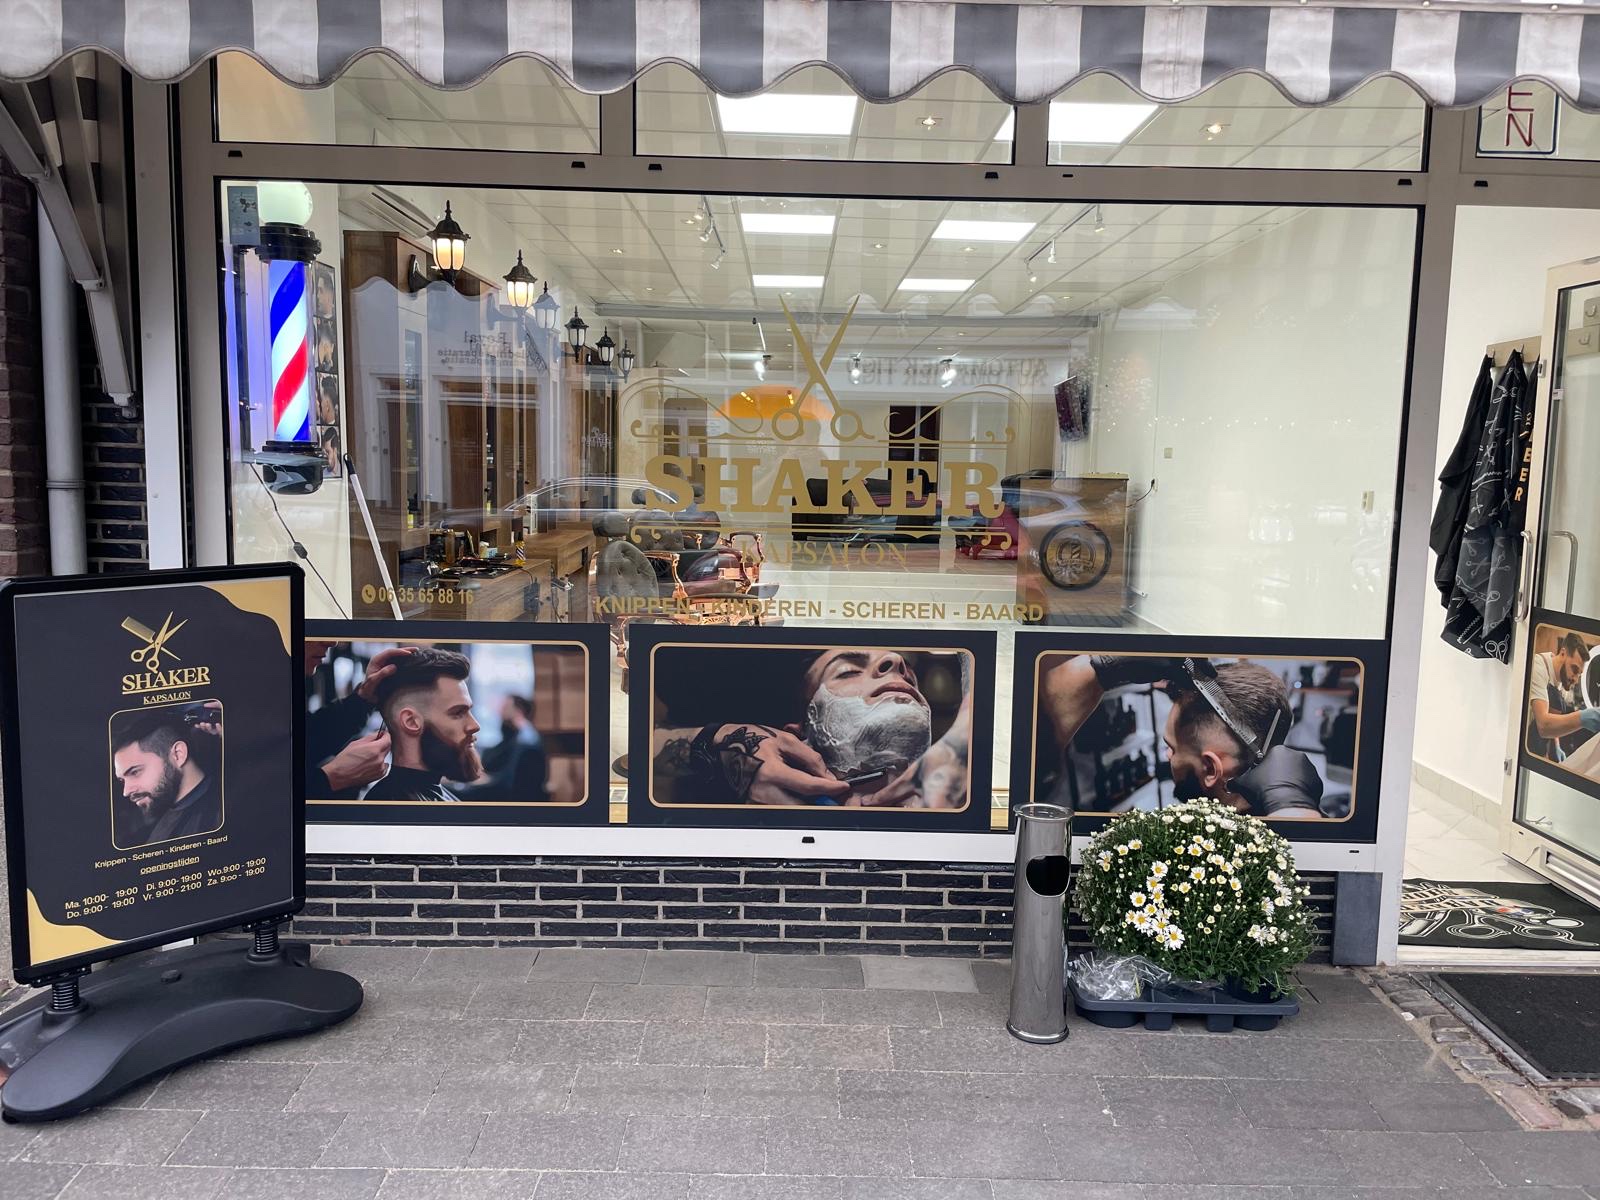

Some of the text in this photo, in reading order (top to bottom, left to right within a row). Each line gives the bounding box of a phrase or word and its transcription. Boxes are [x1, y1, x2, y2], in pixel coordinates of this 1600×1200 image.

[644, 455, 1006, 519] SHAKER
[741, 540, 910, 566] KAPSALON
[378, 586, 474, 604] 06 35 65 88 16
[595, 595, 690, 615] KNIPPEN
[711, 599, 822, 617] KINDEREN
[842, 601, 946, 620] SCHEREN
[966, 602, 1044, 622] BAARD
[122, 666, 210, 691] SHAKER
[143, 691, 191, 705] KAPSALON
[94, 857, 127, 869] Knippen
[132, 849, 164, 861] Scheren
[169, 841, 202, 853] Kinderen
[207, 835, 228, 846] Baard
[115, 886, 139, 898] 19:00
[146, 883, 157, 891] Di.
[181, 872, 202, 883] 19:00
[246, 857, 267, 868] 19:00
[140, 856, 200, 875] openingstijden
[66, 911, 82, 919] Do.
[83, 904, 103, 915] 9:00
[112, 896, 135, 909] 19:00
[143, 893, 154, 901] Vr.
[155, 887, 174, 898] 9:00
[180, 881, 202, 892] 21:00
[244, 866, 265, 877] 19:00
